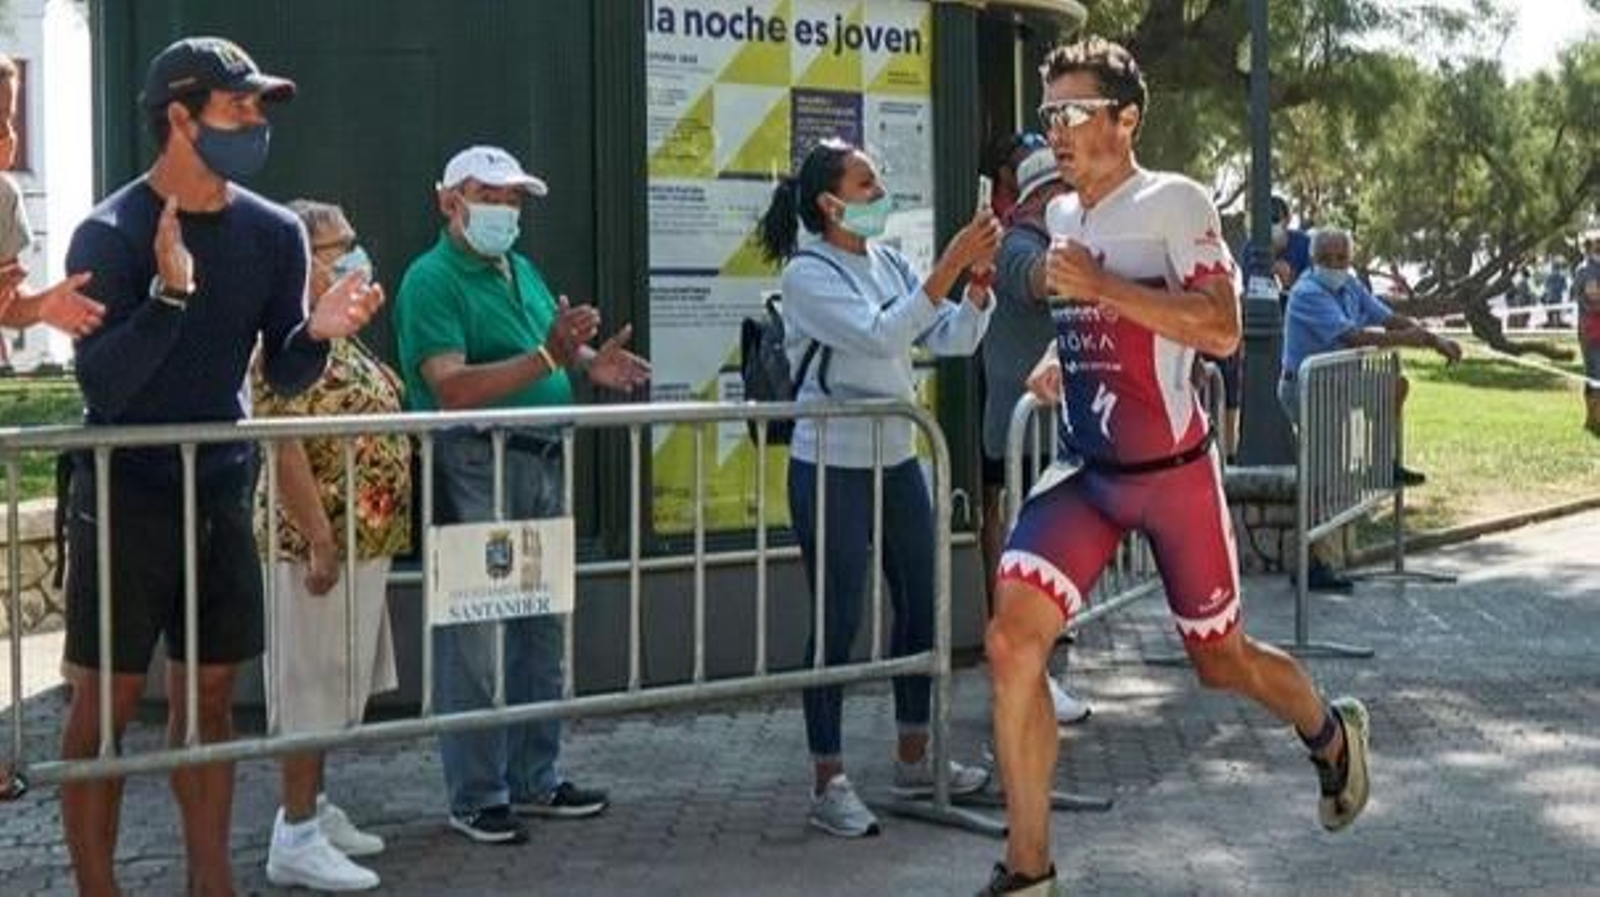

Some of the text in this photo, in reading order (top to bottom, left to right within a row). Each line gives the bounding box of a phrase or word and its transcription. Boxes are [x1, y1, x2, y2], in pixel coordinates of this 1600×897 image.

[648, 0, 922, 56] la noche es joven
[448, 596, 551, 619] SANTANDER
